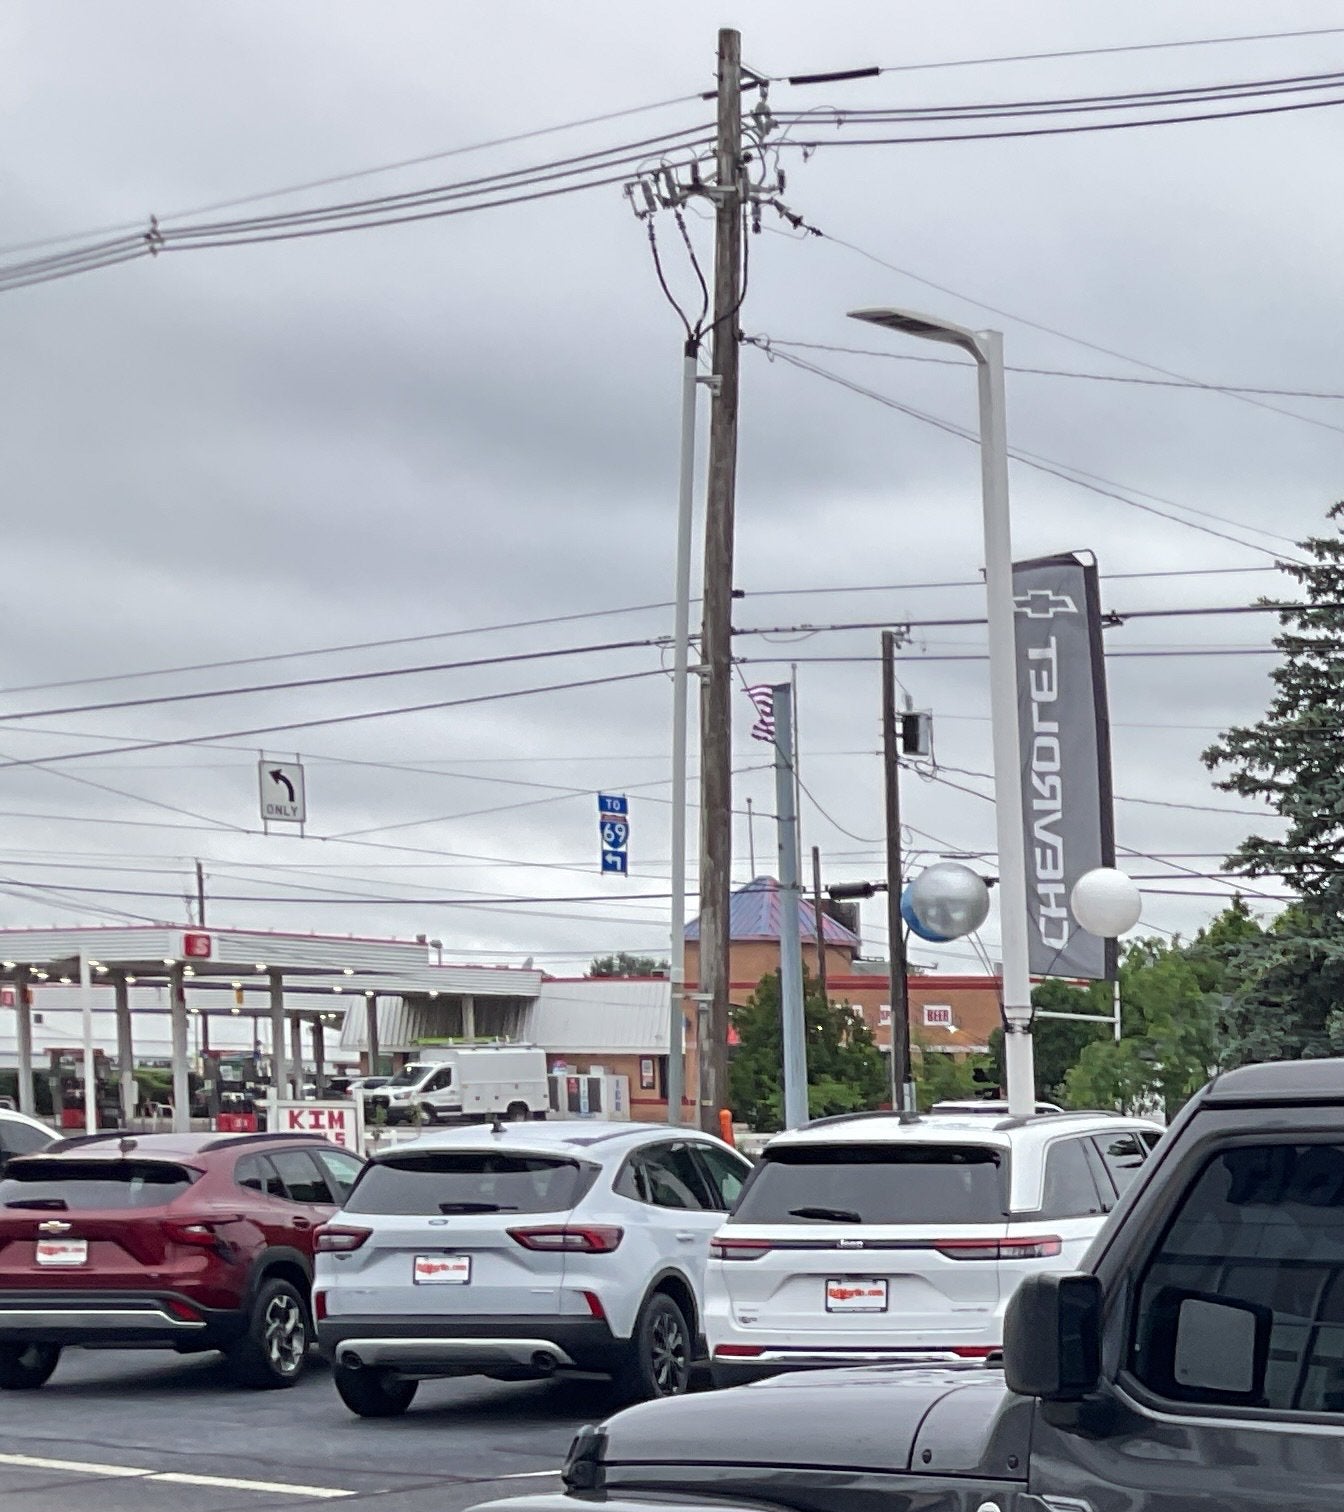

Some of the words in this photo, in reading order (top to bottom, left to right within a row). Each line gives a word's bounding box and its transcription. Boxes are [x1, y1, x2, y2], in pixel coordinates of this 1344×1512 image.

[266, 803, 298, 817] ONLY
[606, 799, 621, 811] TO
[603, 823, 626, 843] 69
[288, 1110, 345, 1129] KIM
